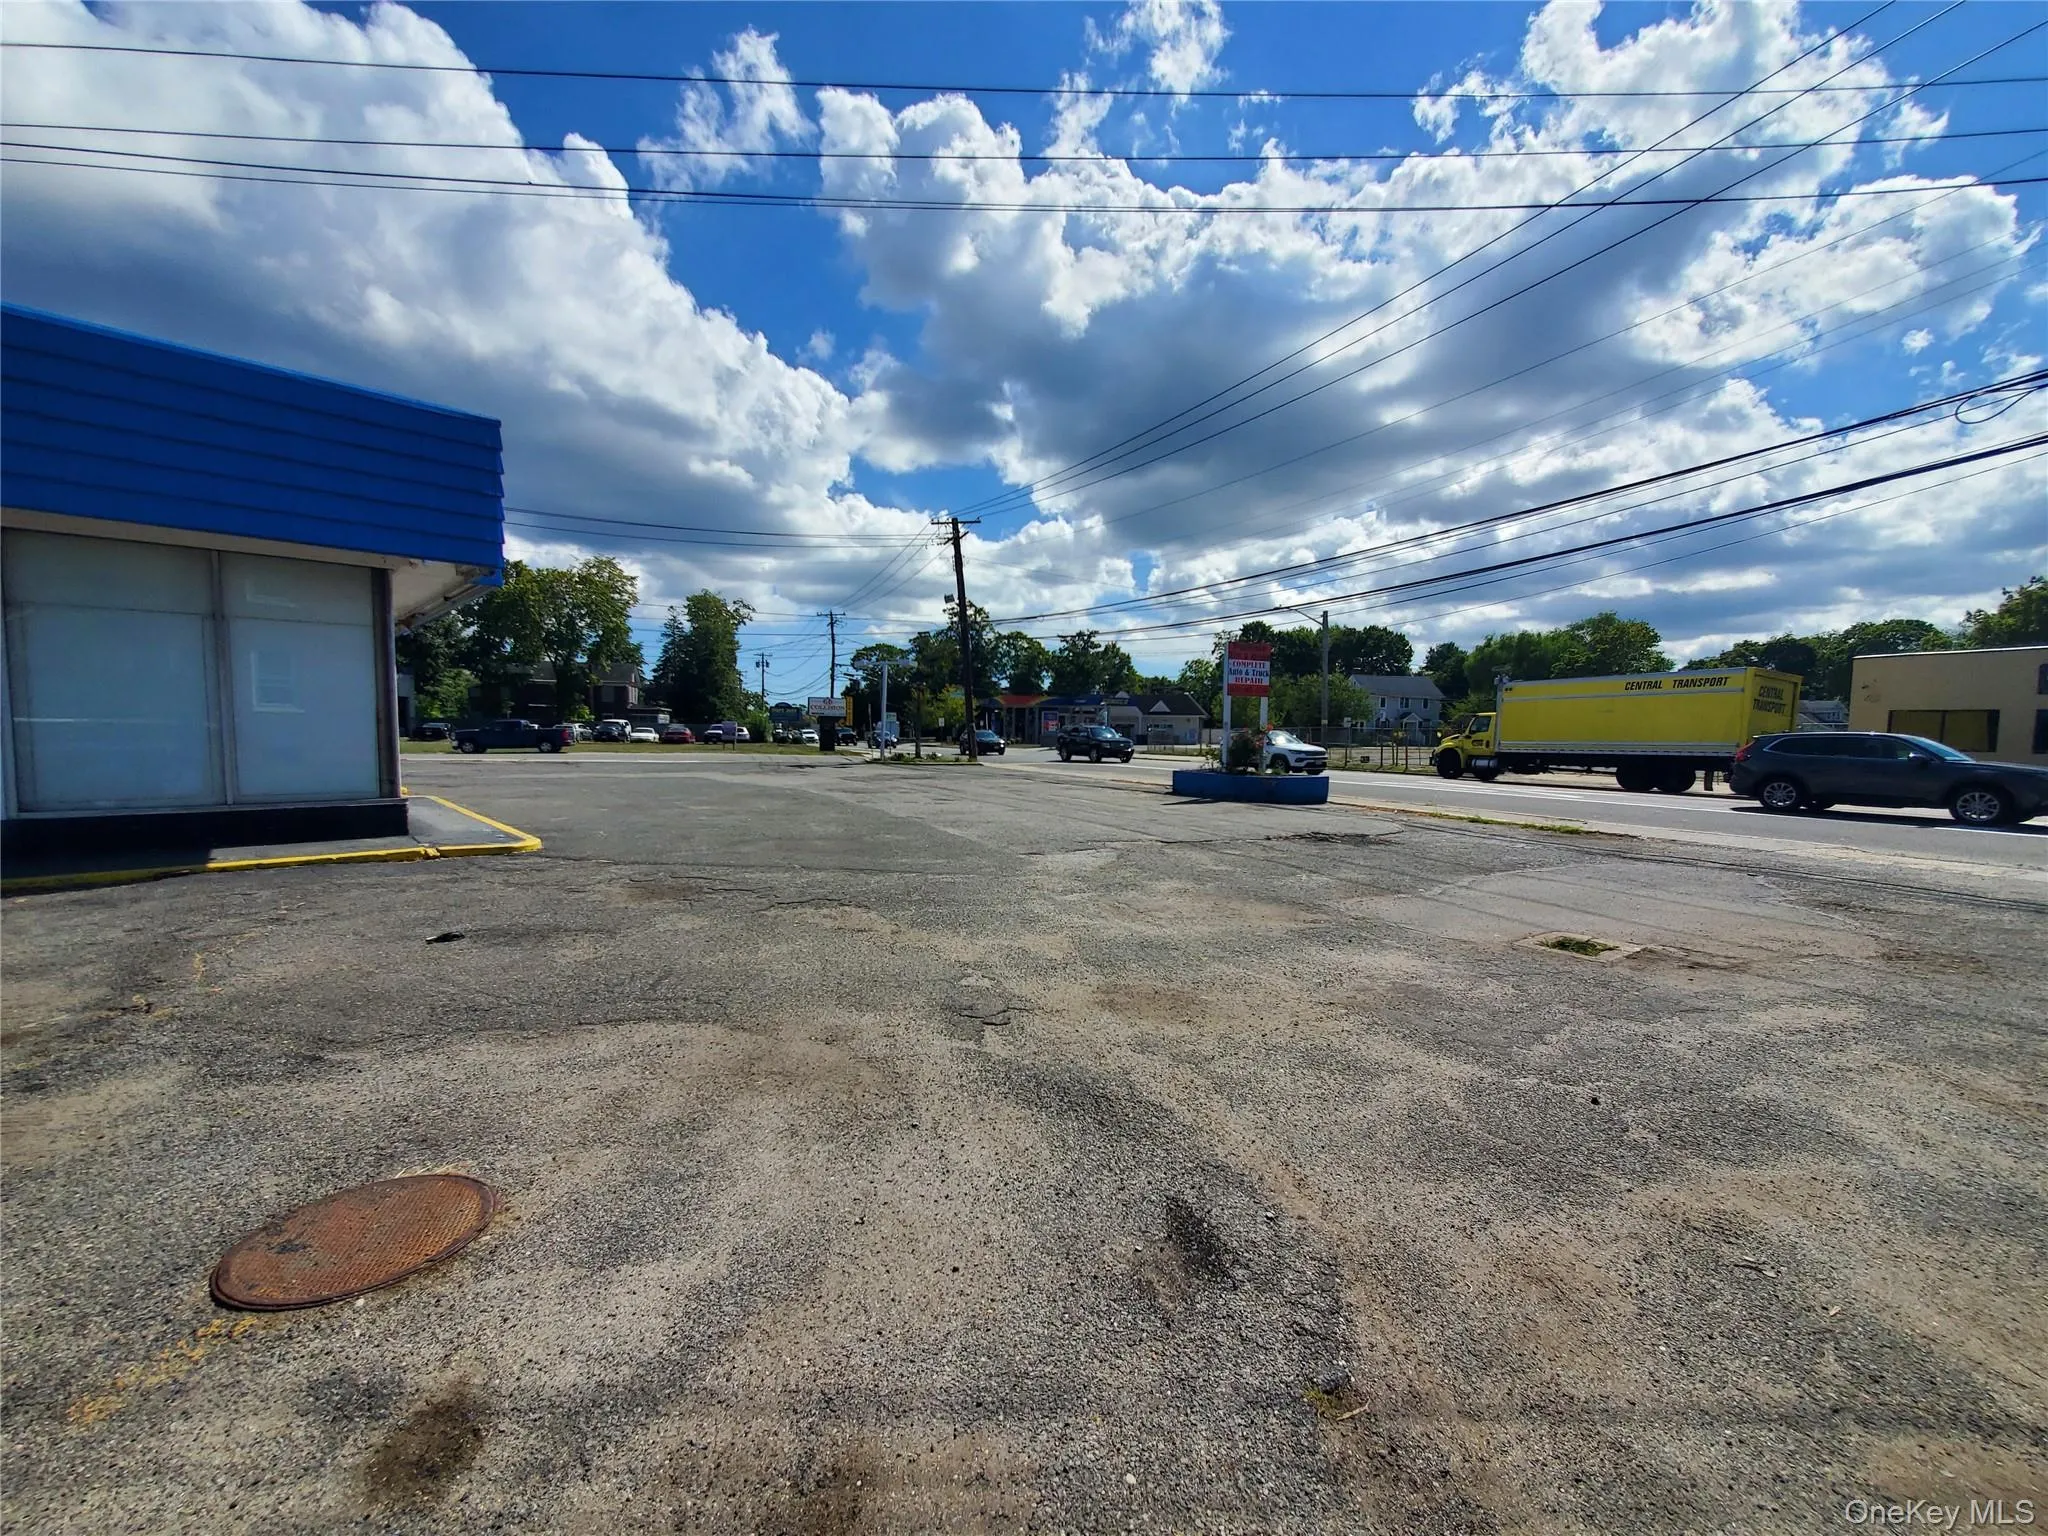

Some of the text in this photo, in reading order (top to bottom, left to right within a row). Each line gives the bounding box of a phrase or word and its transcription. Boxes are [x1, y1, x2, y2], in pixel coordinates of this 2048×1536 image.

[1229, 668, 1242, 676] Auto
[1624, 676, 1730, 691] CENTRAL TRANSPORT
[1758, 686, 1784, 699] CENTRAL
[1753, 699, 1787, 714] TRANSPORT
